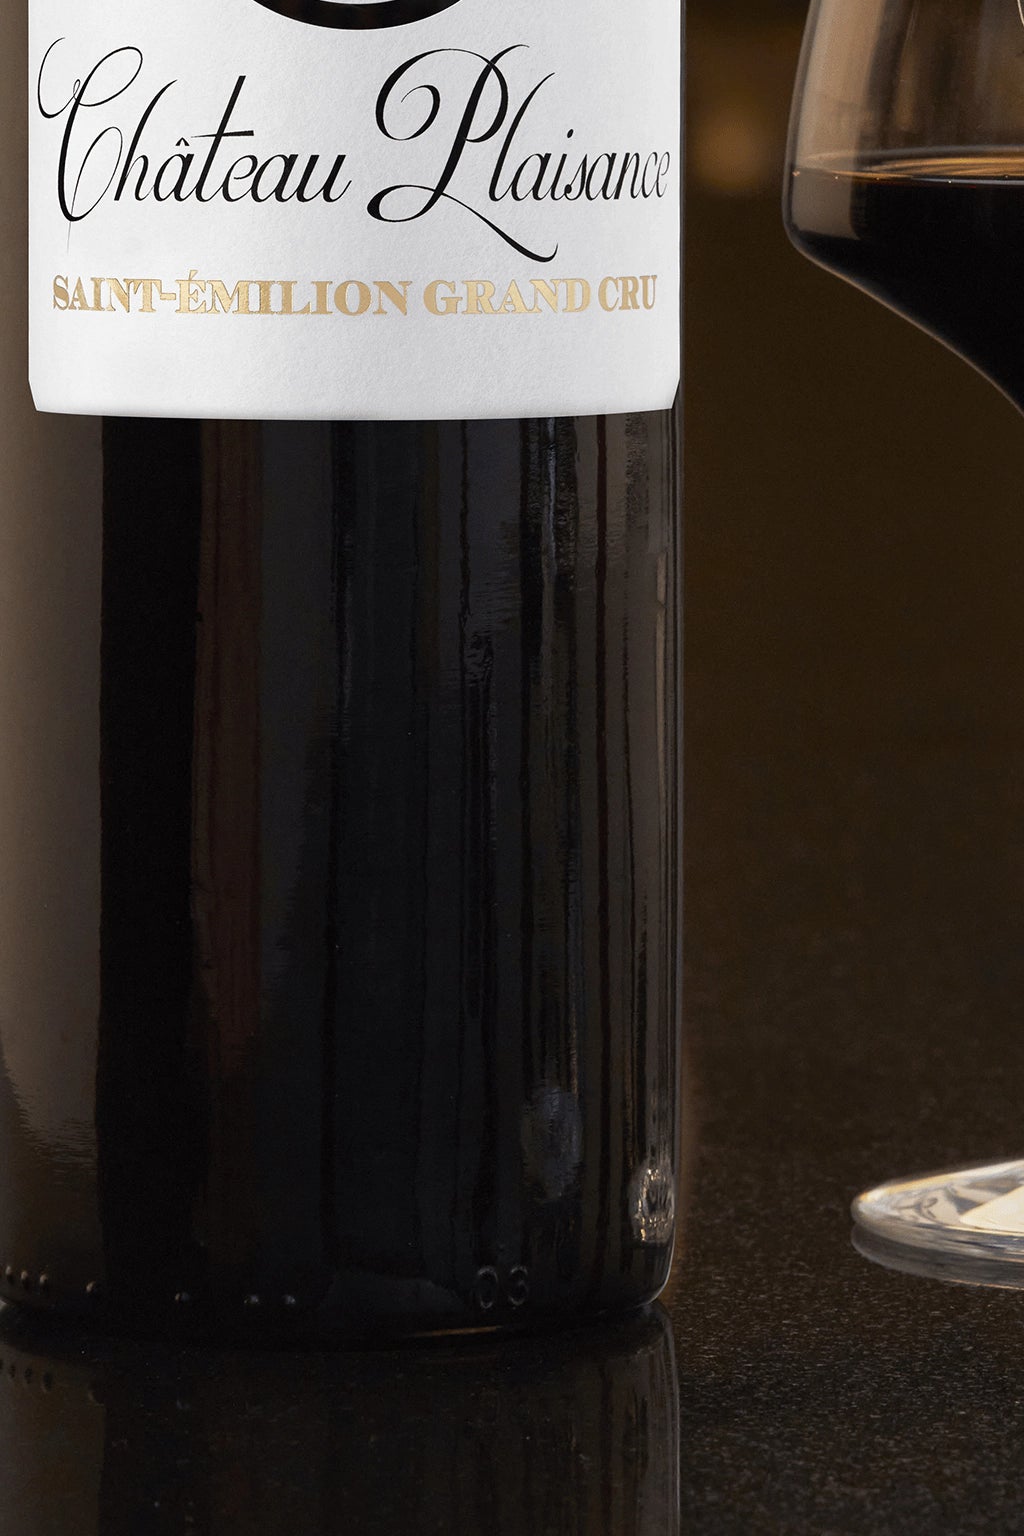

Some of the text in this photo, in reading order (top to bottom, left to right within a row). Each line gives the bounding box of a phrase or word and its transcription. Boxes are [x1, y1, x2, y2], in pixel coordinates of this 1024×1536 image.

[37, 37, 672, 263] Château Plaisance
[52, 269, 657, 317] SAINT-ÉMILION GRAND CRU
